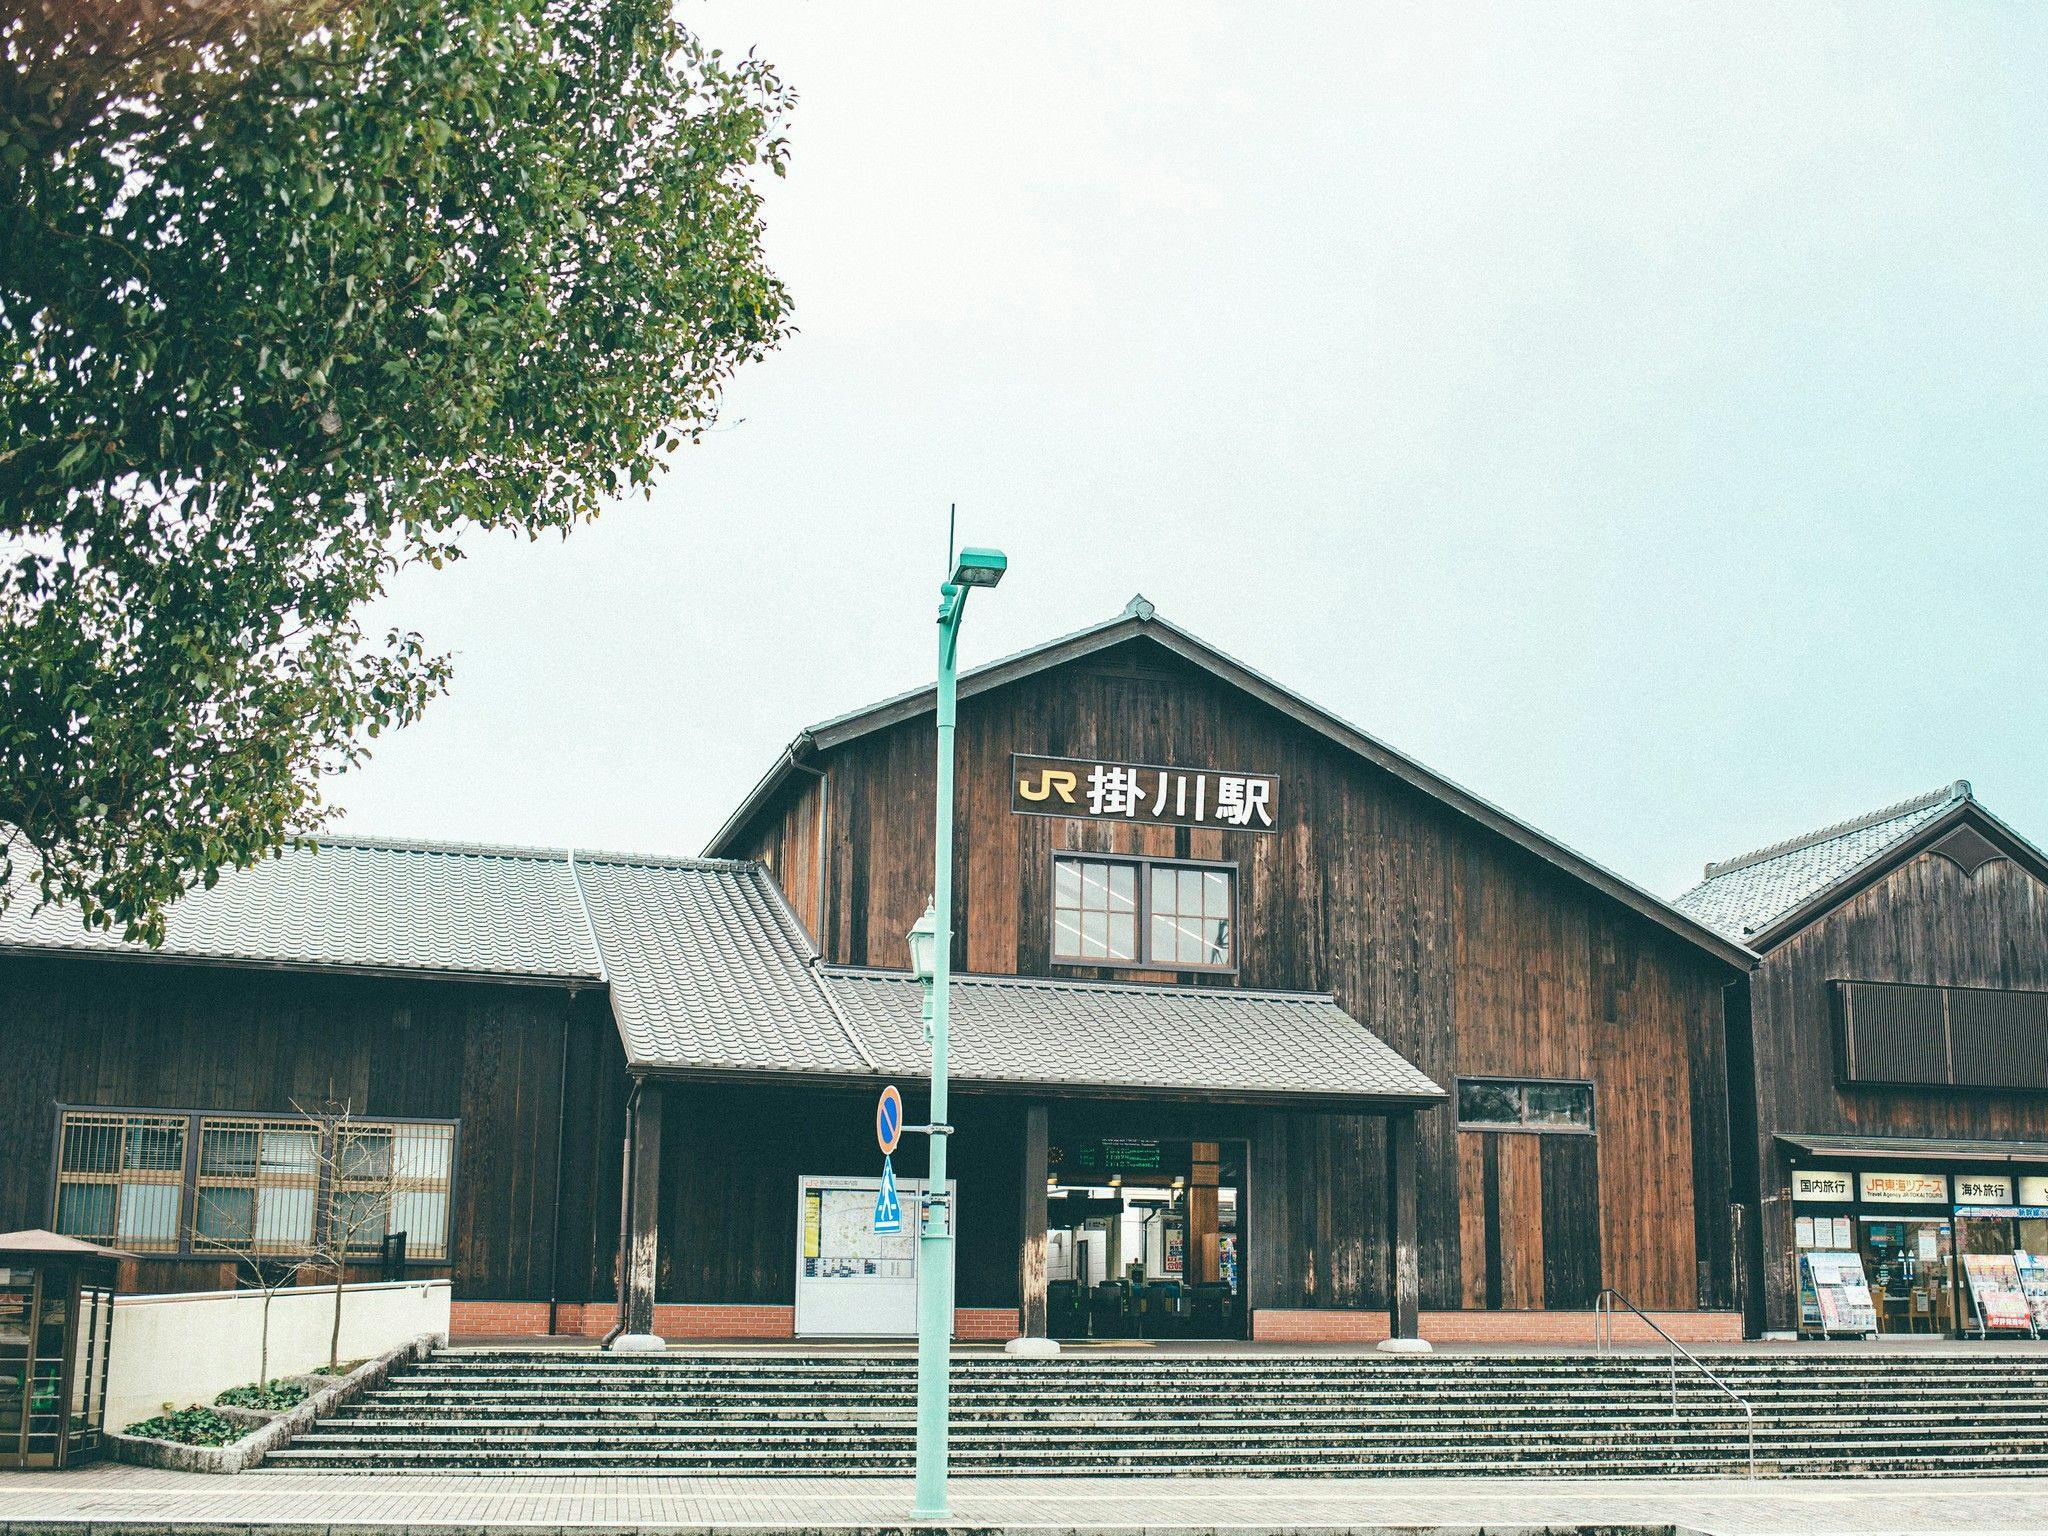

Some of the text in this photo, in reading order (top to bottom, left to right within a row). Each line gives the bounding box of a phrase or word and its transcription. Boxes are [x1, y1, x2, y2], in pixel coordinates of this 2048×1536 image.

[1019, 765, 1273, 827] JR 掛川駅
[1800, 1179, 1846, 1193] 国内旅行
[1866, 1178, 1943, 1192] JR東海ツアーズ
[1961, 1183, 2005, 1197] 海外旅行
